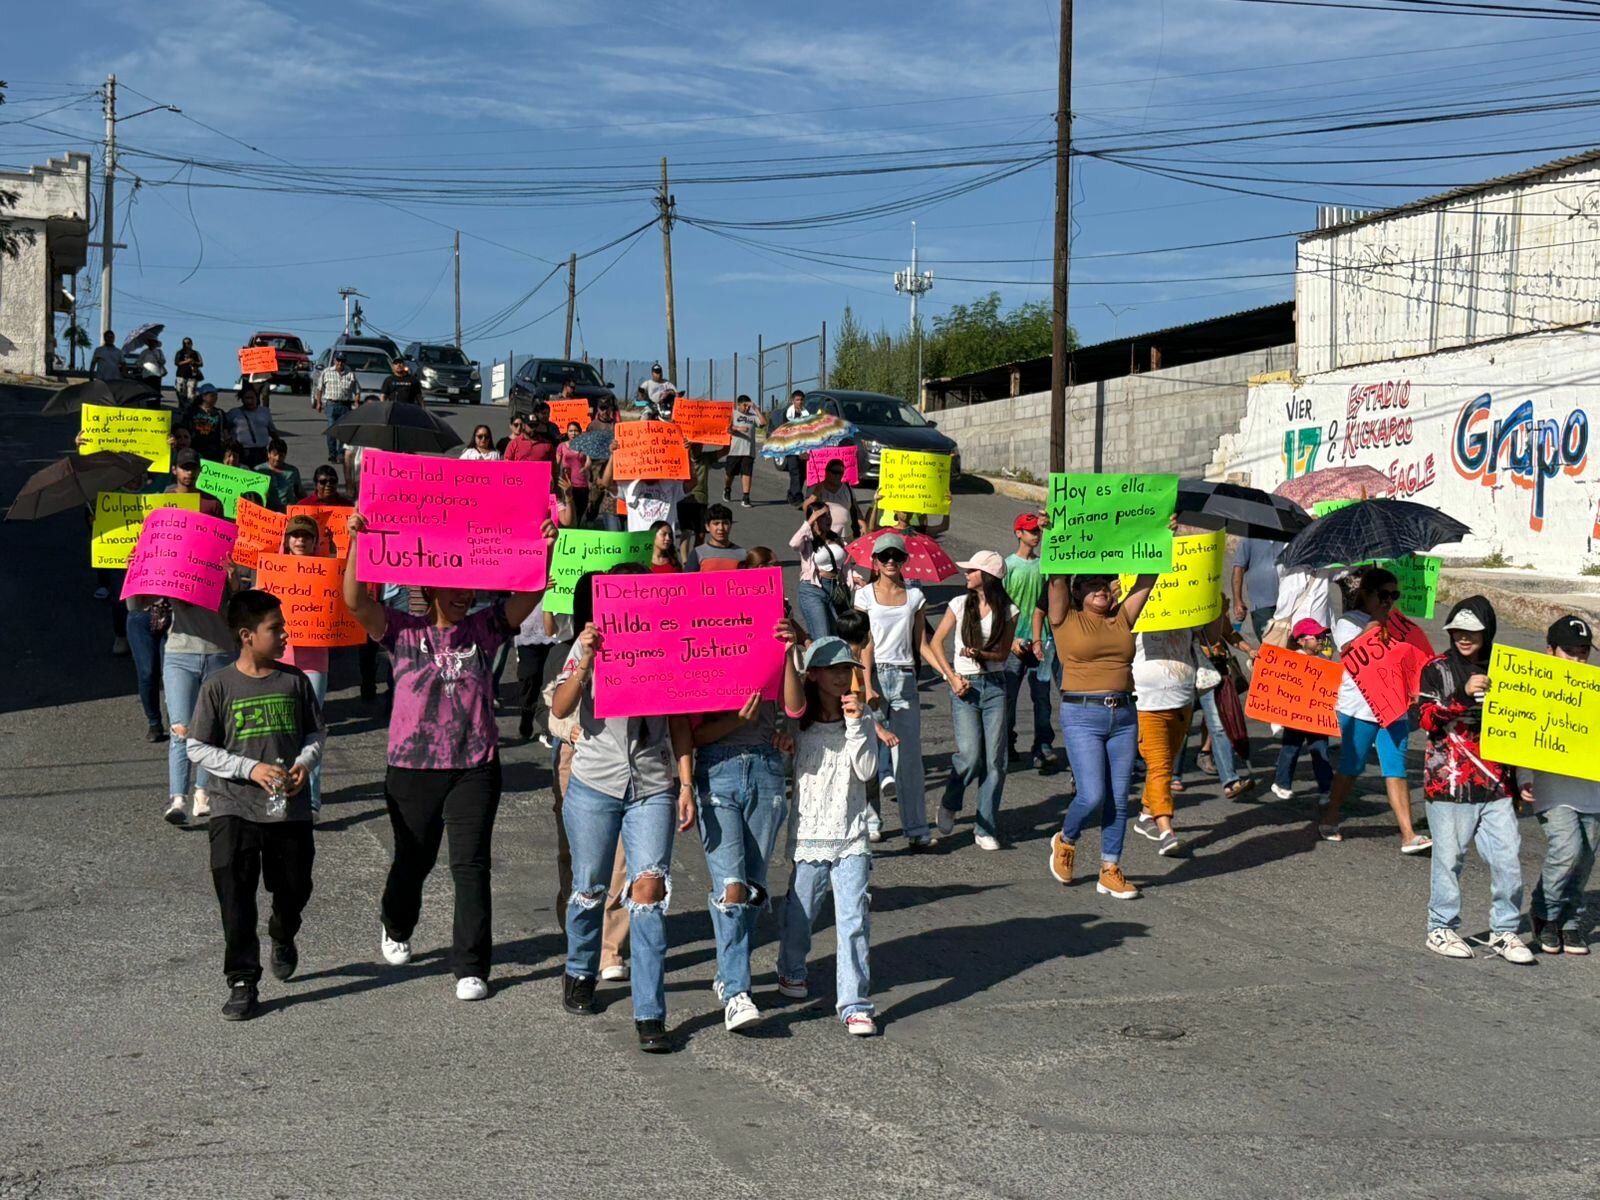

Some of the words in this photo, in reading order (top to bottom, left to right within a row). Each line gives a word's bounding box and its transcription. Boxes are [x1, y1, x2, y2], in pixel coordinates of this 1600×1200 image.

[1346, 379, 1412, 420] ESTADIO
[105, 410, 139, 426] justicia
[1341, 415, 1414, 460] KICKAPOO
[885, 452, 896, 465] En
[1281, 426, 1323, 481] 17
[1451, 392, 1589, 535] Grupo
[363, 456, 444, 482] ¡Libertad
[454, 472, 490, 487] para
[502, 472, 524, 487] las
[1386, 453, 1438, 500] EAGLE
[368, 483, 478, 511] trabajadoras
[1054, 476, 1087, 506] Hoy
[1096, 485, 1112, 496] es
[195, 523, 208, 534] no
[369, 509, 448, 526] inocentes!
[466, 520, 513, 535] Familia
[1051, 505, 1109, 531] Mañana
[1115, 504, 1156, 526] puedes
[151, 532, 183, 545] precio
[466, 537, 501, 548] quiere
[557, 533, 577, 557] ¡La
[581, 538, 622, 560] justicia
[629, 544, 640, 555] no
[1050, 533, 1073, 545] ser
[1078, 528, 1095, 543] tu
[365, 530, 464, 569] Justicia
[470, 549, 513, 558] justicia
[1049, 544, 1097, 562] Justicia
[1101, 548, 1124, 562] para
[1131, 541, 1163, 560] Hilda
[259, 557, 288, 573] ¡Que
[297, 561, 329, 577] hable
[323, 587, 340, 599] no
[595, 579, 688, 606] ¡Detengan
[701, 581, 716, 597] la
[726, 576, 775, 598] farsa!
[601, 611, 652, 636] Hilda
[660, 619, 680, 632] es
[691, 611, 754, 629] inocente
[601, 646, 666, 668] Exigimos
[1496, 649, 1554, 681] ¡Justicia
[631, 673, 675, 685] somos
[684, 667, 726, 684] ciegos
[1284, 660, 1298, 671] no
[1304, 659, 1323, 681] hay
[1276, 686, 1302, 704] haya
[1498, 680, 1538, 698] pueblo
[1247, 694, 1289, 717] Justicia
[1487, 700, 1538, 725] Exigimos
[1540, 711, 1590, 736] justicia
[1486, 726, 1518, 740] para
